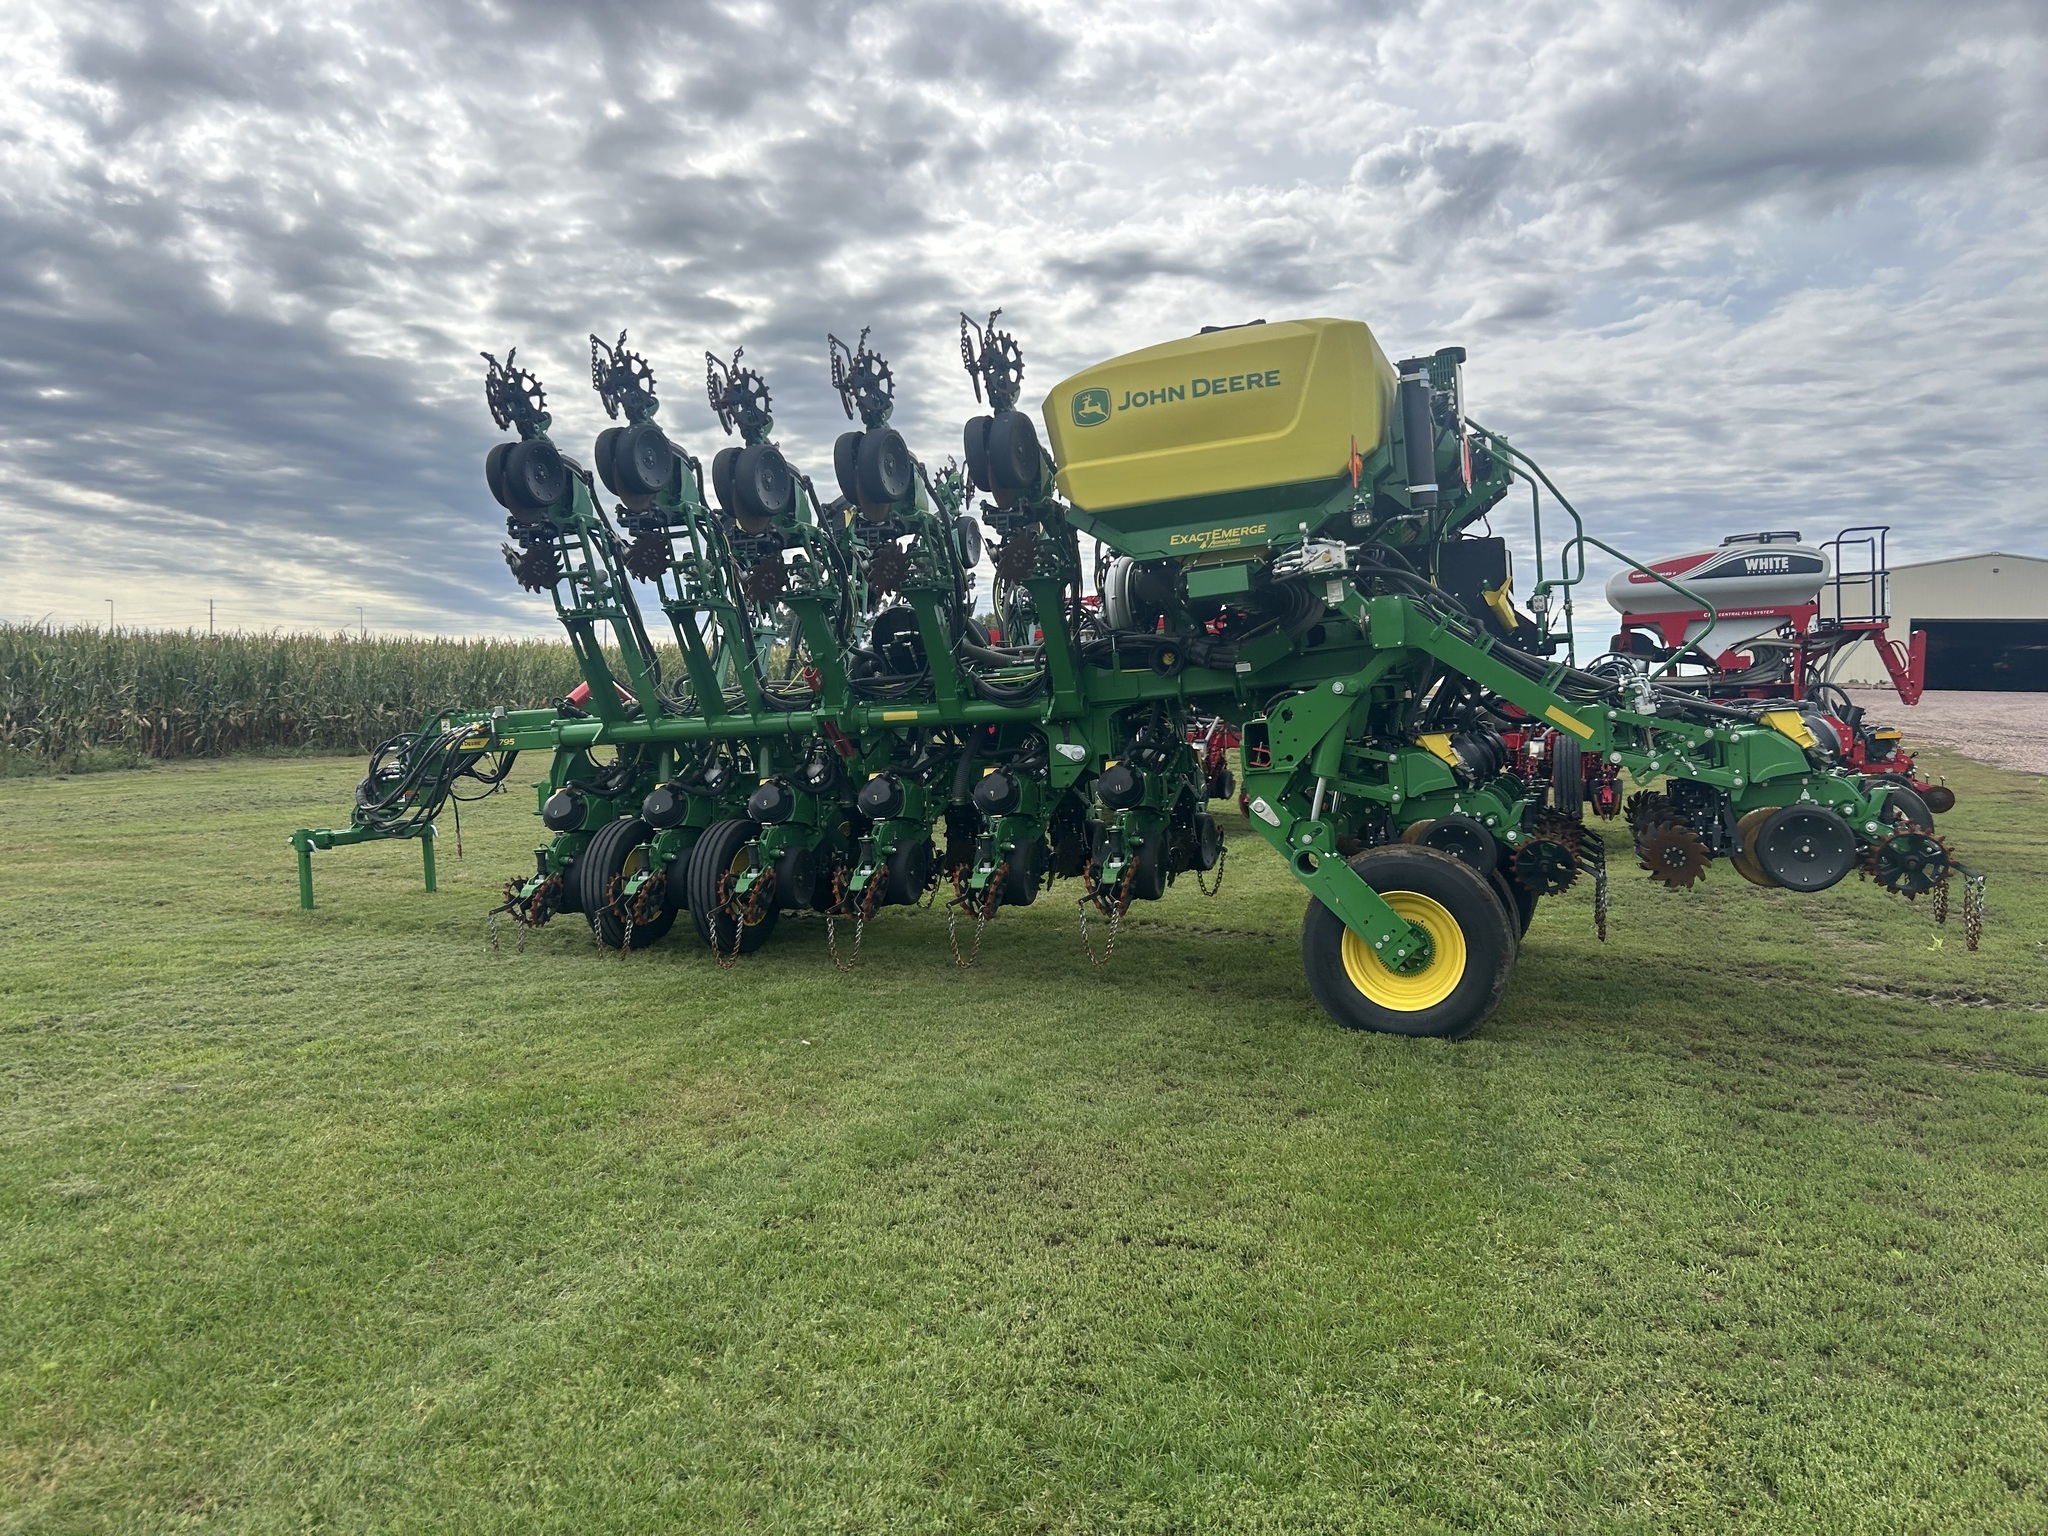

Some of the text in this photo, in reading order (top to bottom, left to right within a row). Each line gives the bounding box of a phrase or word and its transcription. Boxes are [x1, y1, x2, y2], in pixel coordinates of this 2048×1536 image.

[1117, 369, 1281, 411] JOHN DEERE
[1169, 523, 1267, 546] EXACTEMERGE
[1744, 556, 1789, 571] WHITE
